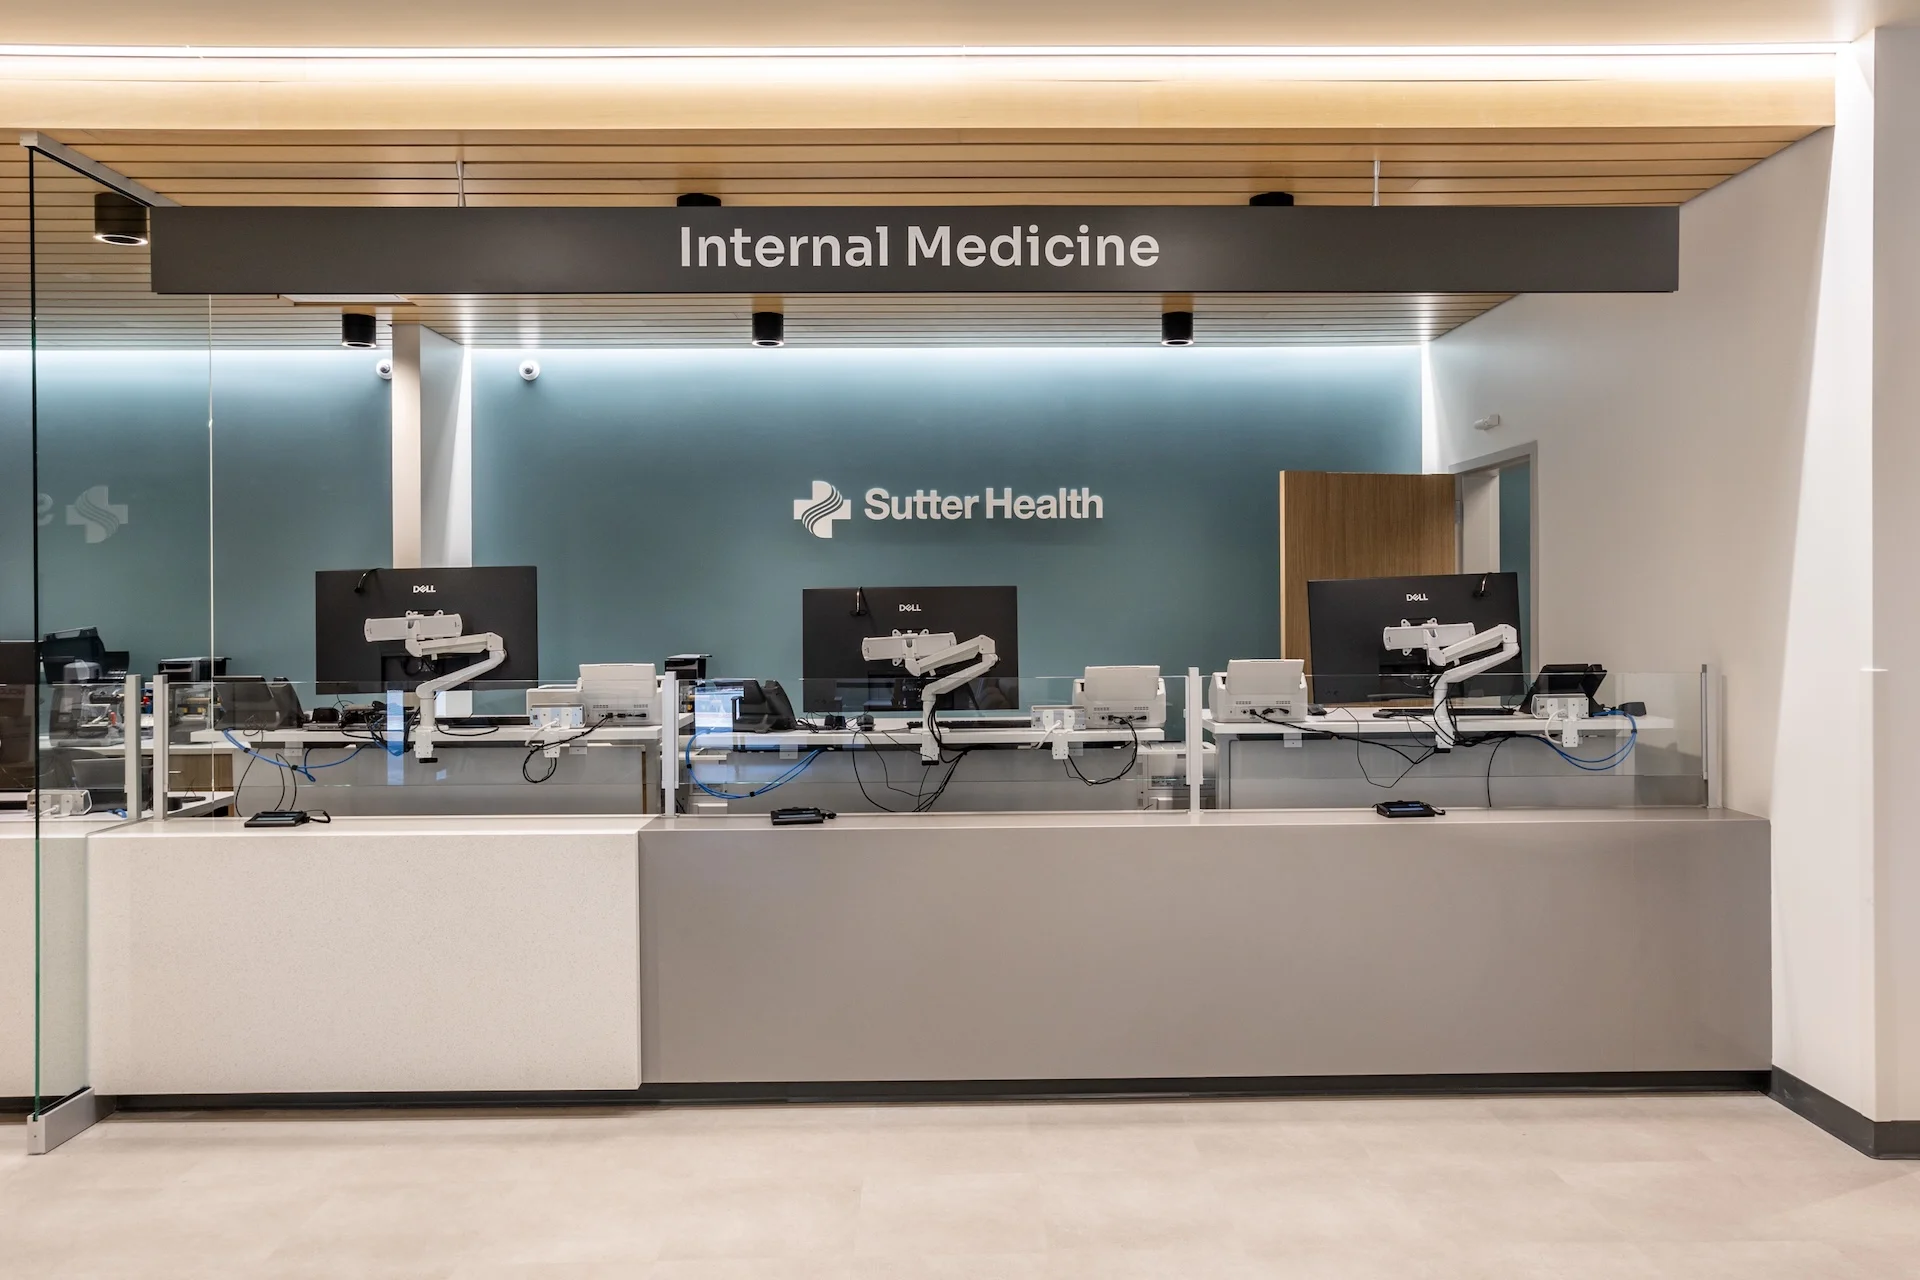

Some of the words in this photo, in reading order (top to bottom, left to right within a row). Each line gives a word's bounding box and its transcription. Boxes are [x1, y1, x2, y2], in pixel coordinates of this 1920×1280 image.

[681, 226, 889, 267] Internal
[908, 225, 1160, 267] Medicine
[865, 488, 980, 520] Sutter
[985, 487, 1104, 519] Health
[412, 585, 437, 594] DELL
[1405, 593, 1429, 601] DELL
[898, 604, 922, 612] DELL
